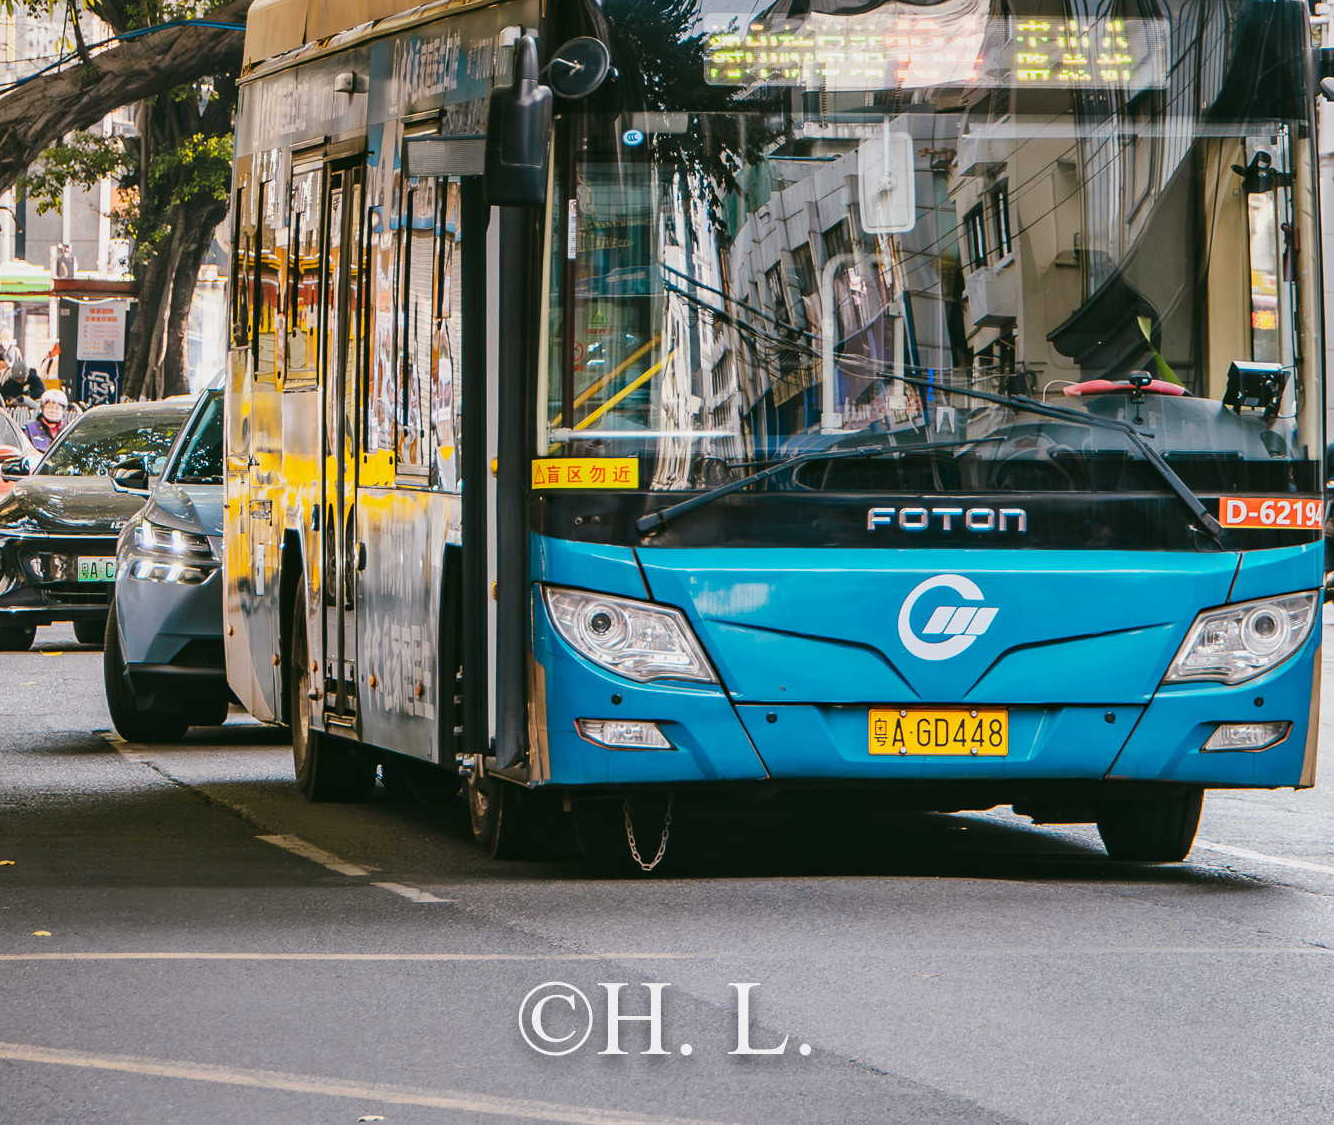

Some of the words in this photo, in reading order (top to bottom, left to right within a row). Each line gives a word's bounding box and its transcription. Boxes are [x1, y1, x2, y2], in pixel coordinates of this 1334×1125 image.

[546, 465, 631, 484] 盲区勿近
[867, 507, 1028, 533] FOTON
